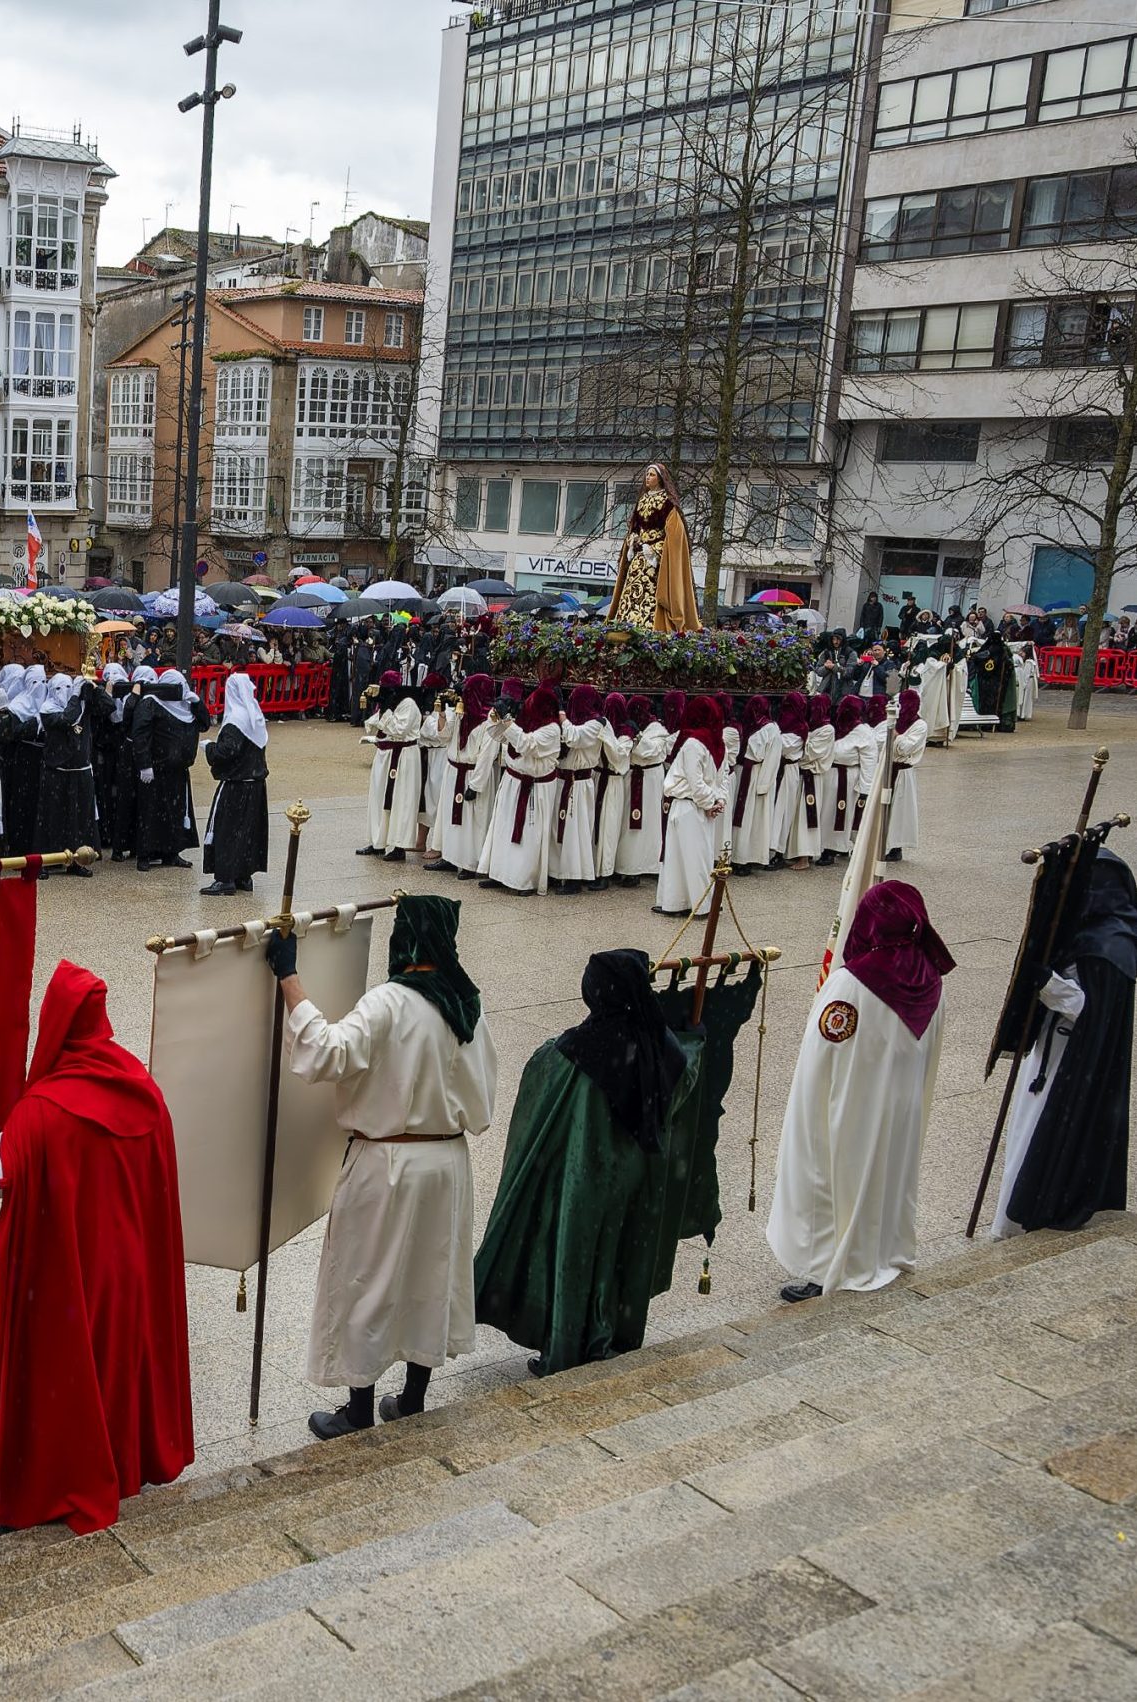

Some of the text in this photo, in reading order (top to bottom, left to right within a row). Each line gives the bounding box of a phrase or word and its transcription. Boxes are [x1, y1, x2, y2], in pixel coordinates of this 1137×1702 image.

[226, 551, 252, 560] FARMACI
[296, 554, 336, 562] FARMACIA
[528, 557, 618, 577] VITALDEN
